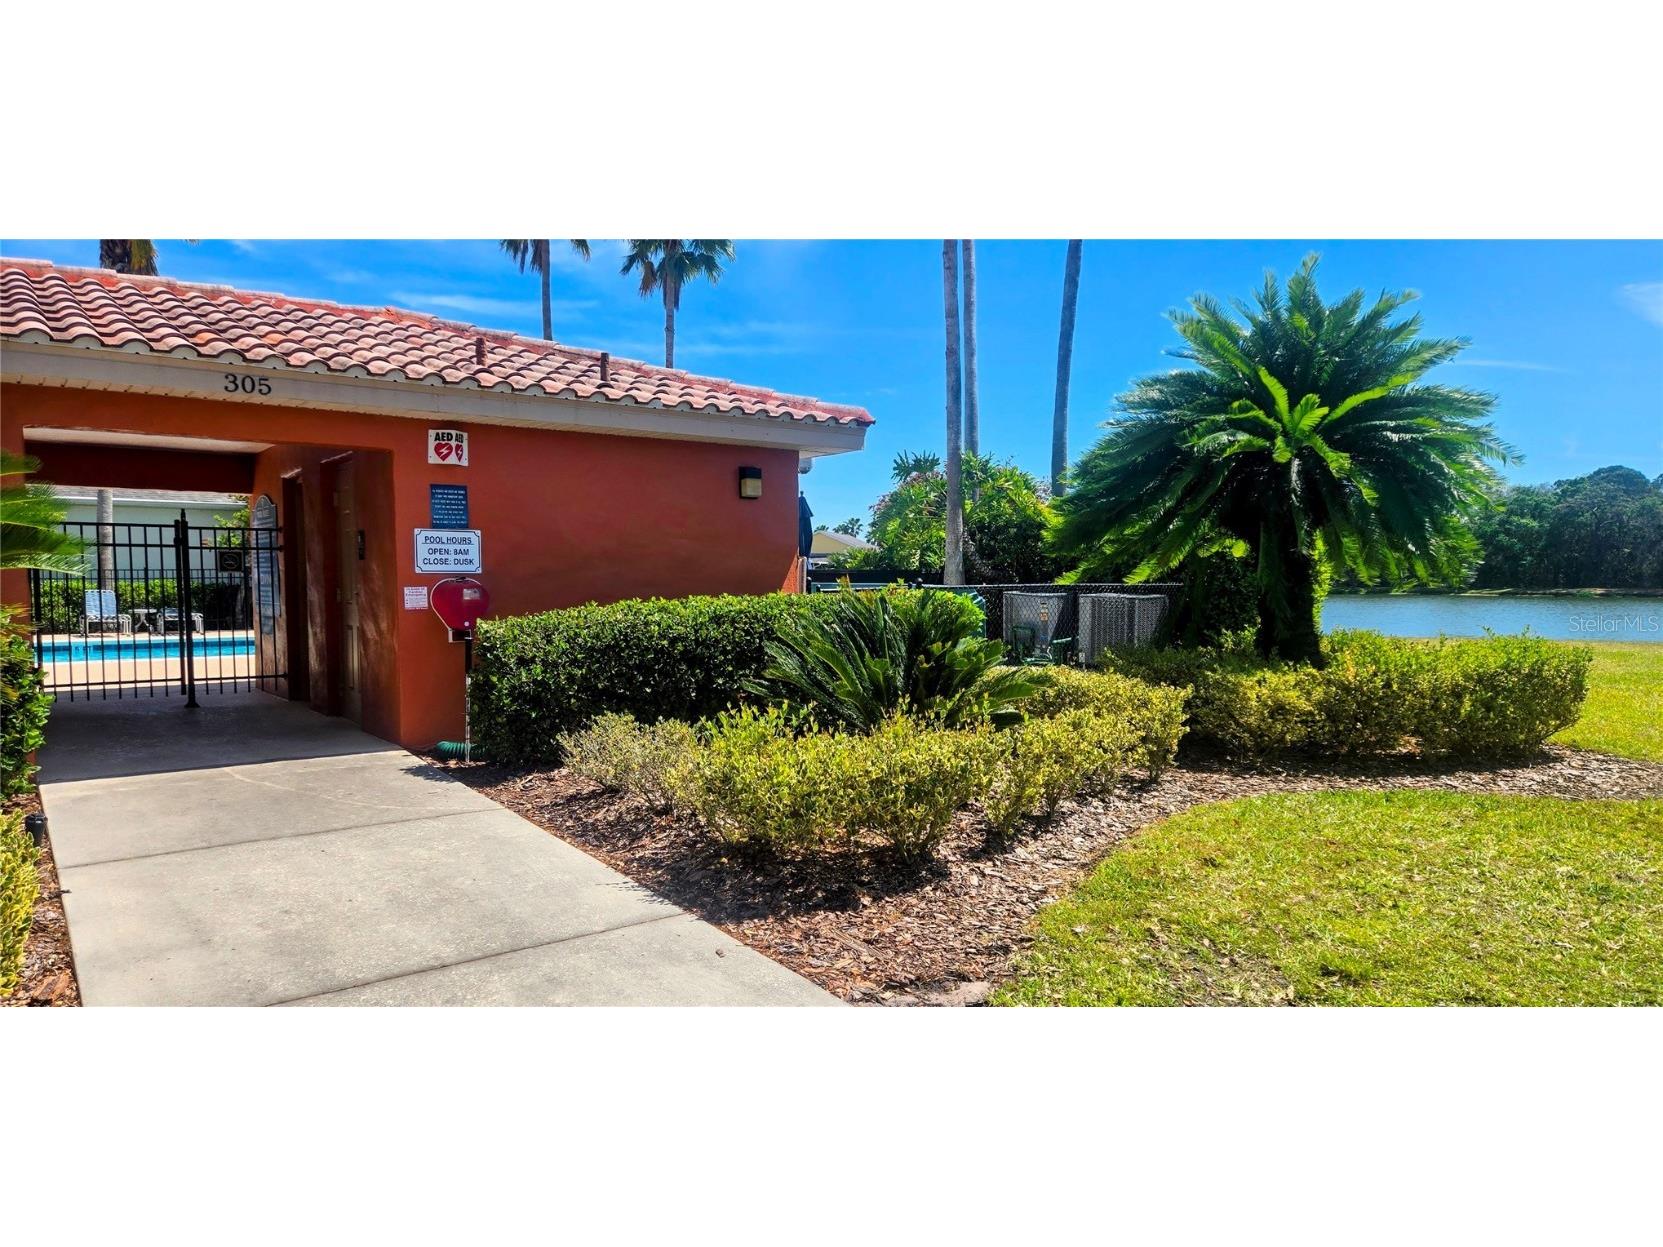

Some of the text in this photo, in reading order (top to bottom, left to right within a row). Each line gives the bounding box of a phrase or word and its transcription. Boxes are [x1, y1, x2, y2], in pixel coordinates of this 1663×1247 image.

[224, 373, 272, 396] 305
[434, 432, 454, 442] AED
[454, 432, 464, 444] AED
[424, 535, 472, 545] POOL HOURS
[427, 547, 470, 556] OPEN: 8AM
[422, 557, 475, 566] CLOSE: DUSK
